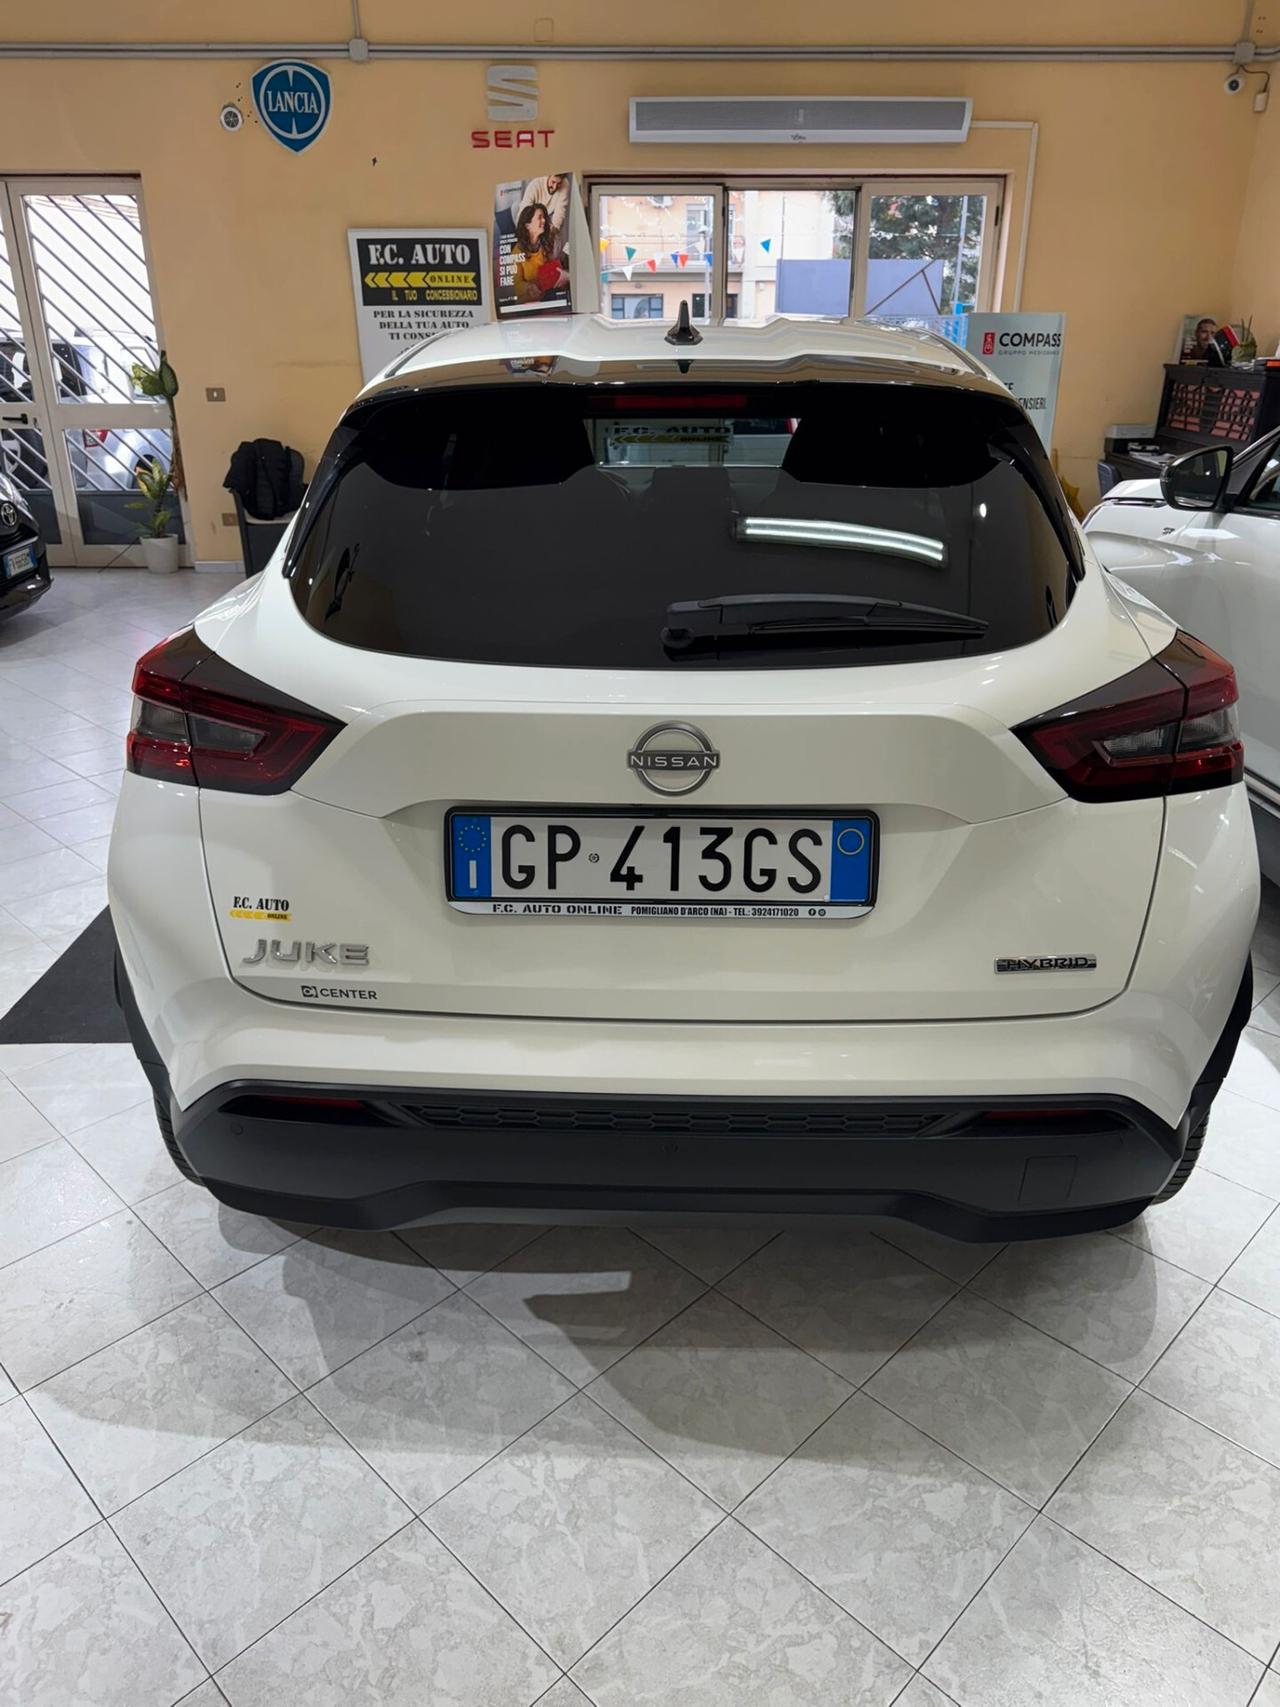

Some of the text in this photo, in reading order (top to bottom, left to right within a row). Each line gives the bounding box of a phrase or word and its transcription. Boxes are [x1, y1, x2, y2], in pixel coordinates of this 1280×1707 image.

[266, 89, 320, 115] LANCIA
[471, 130, 555, 148] SEAT
[368, 243, 471, 265] F.C. AUTO
[499, 244, 512, 255] CON
[499, 252, 526, 265] COMPASS
[429, 274, 471, 283] ONLINE
[499, 275, 515, 287] FARE
[404, 290, 418, 300] TUO
[425, 290, 478, 300] CONCESSIONARIO
[373, 310, 474, 318] PER LA SICUREZZA
[379, 321, 469, 329] DELLA TUA AUTO
[388, 332, 400, 340] TI
[998, 332, 1062, 348] COMPASS
[630, 755, 718, 767] NISSAN
[501, 824, 823, 894] GP 413GS
[233, 896, 290, 911] F.C. AUTO
[267, 912, 288, 920] ONLINE
[492, 904, 518, 913] F.C.
[522, 904, 562, 914] AUTO
[566, 905, 623, 915] ONLINE
[631, 906, 679, 915] POMIGLIANO
[680, 906, 709, 916] D'ARCO
[751, 908, 799, 917] 3924171020
[242, 938, 370, 966] JUKE
[1005, 956, 1089, 970] HYBRID
[319, 987, 377, 1000] CENTER
